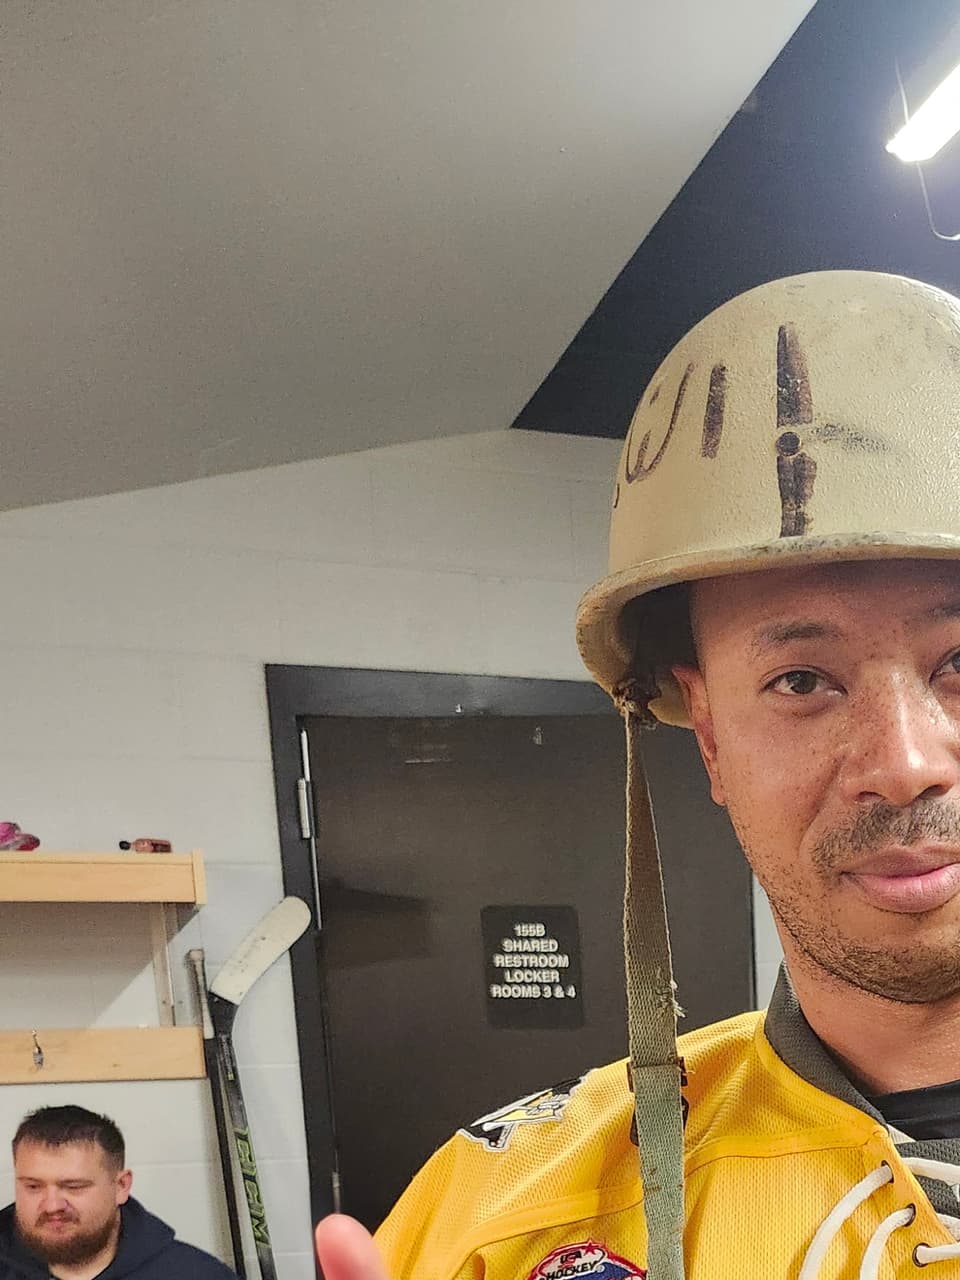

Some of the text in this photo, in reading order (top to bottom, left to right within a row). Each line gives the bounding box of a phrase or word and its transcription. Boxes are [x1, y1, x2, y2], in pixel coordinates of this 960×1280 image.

[514, 923, 546, 937] 155B
[502, 938, 559, 953] SHARED
[493, 953, 570, 968] RESTROOM
[504, 968, 560, 983] LOCKER
[489, 983, 576, 998] ROOMS 3 & 4
